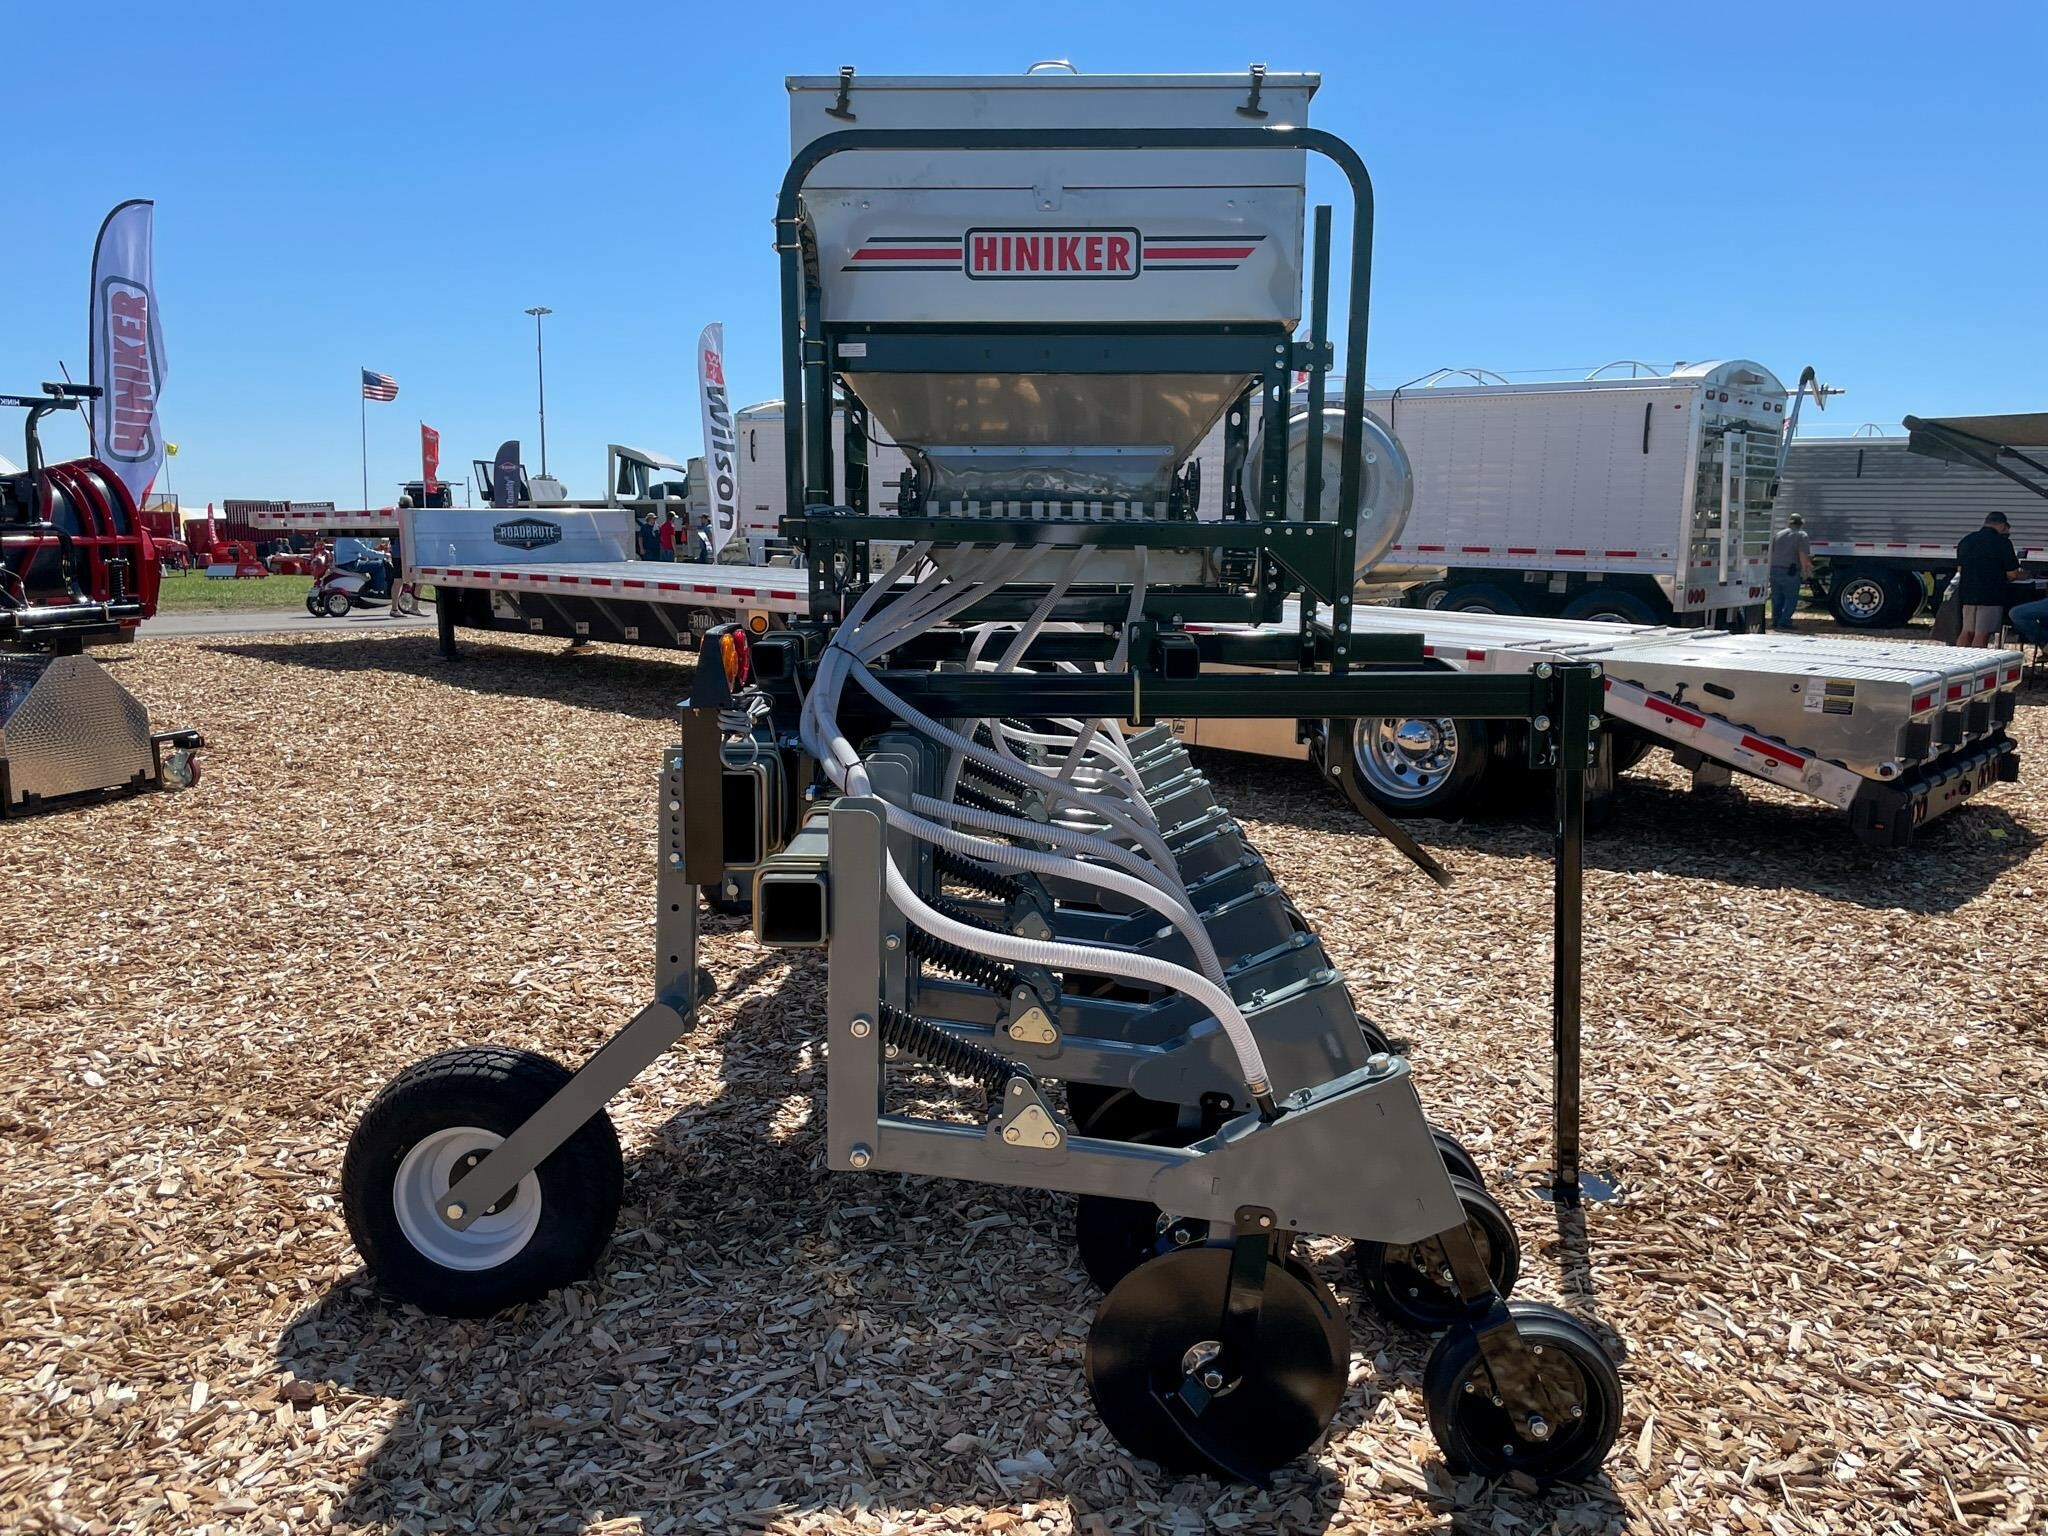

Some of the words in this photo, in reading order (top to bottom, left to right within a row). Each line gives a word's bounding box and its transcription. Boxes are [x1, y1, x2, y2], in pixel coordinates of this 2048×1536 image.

[974, 236, 1131, 271] HINIKER
[111, 290, 153, 450] HINIKER
[706, 386, 736, 531] Wilson
[500, 525, 555, 539] ROADBRUTE
